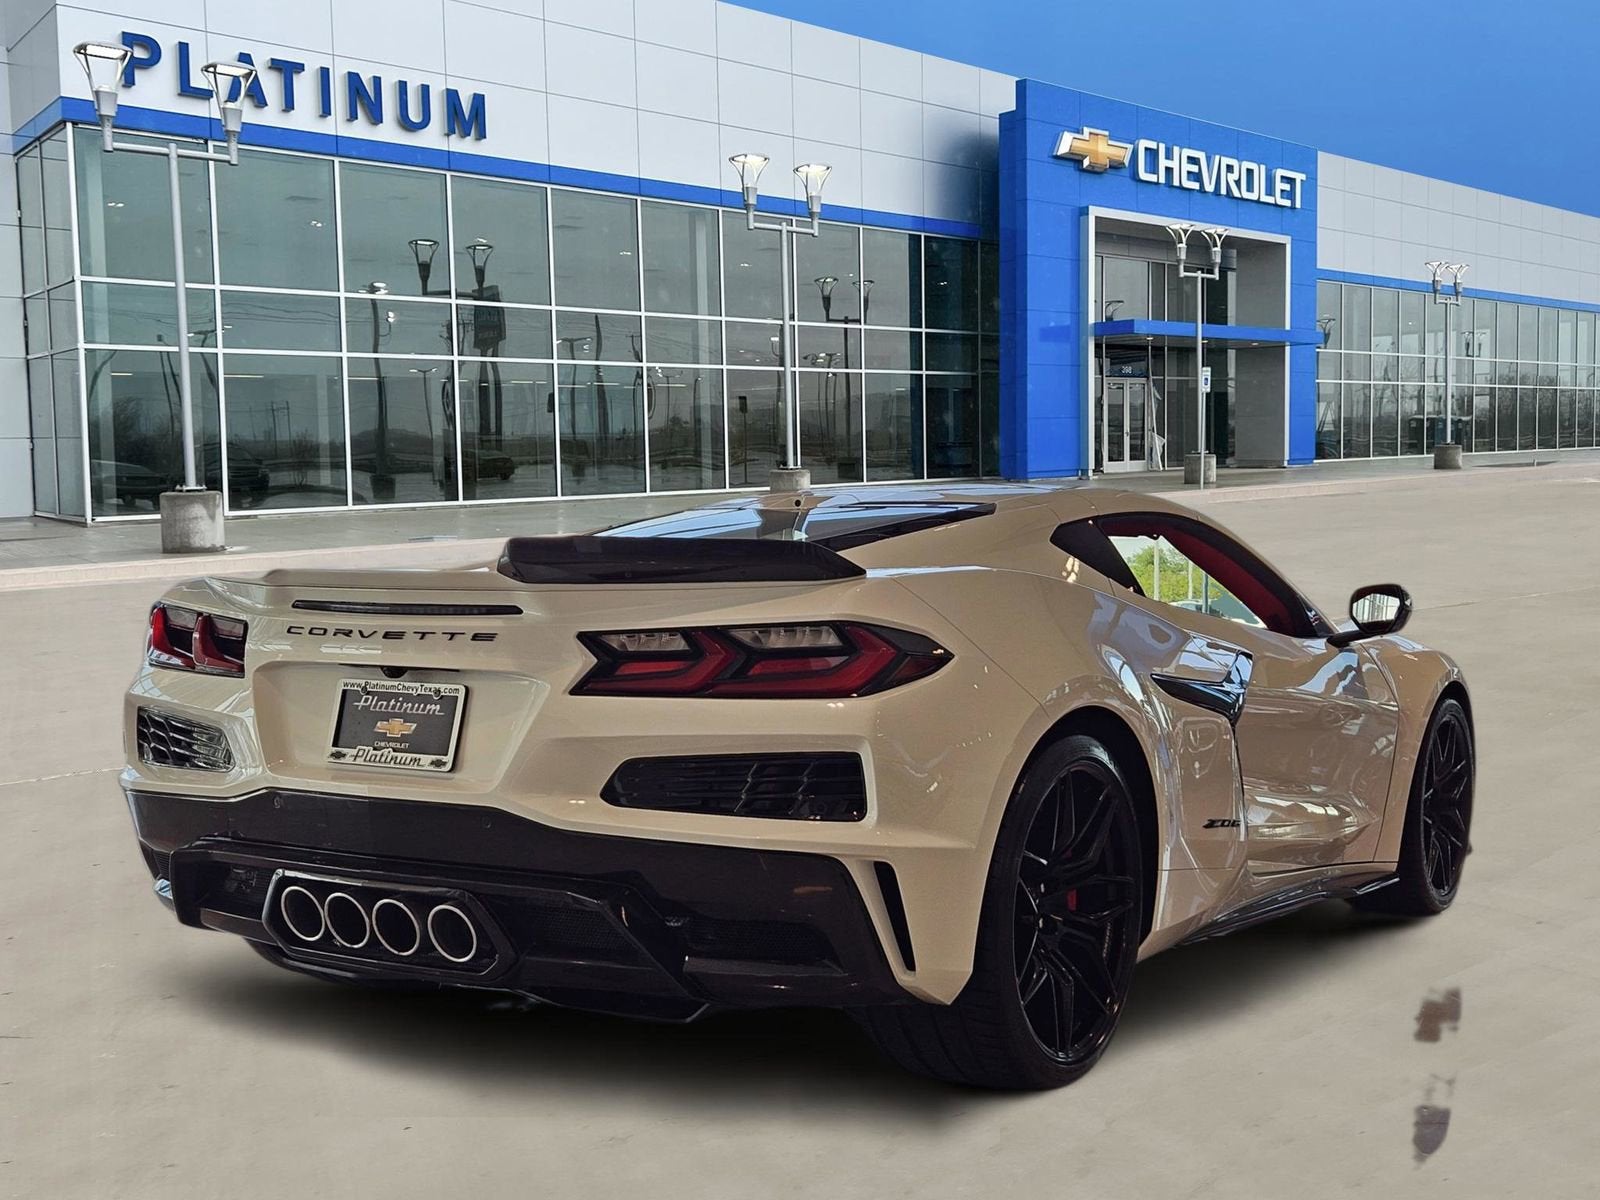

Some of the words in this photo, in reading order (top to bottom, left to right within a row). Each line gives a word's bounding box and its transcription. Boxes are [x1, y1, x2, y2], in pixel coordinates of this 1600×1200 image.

[121, 31, 487, 140] PLATINUM
[1135, 138, 1307, 209] CHEVROLET
[286, 625, 499, 642] CORVETTE
[342, 680, 460, 695] www.PlatinumChevyTexas.com
[353, 694, 445, 716] Platinum
[374, 740, 410, 749] CHEVROLET
[349, 748, 427, 768] Platinum
